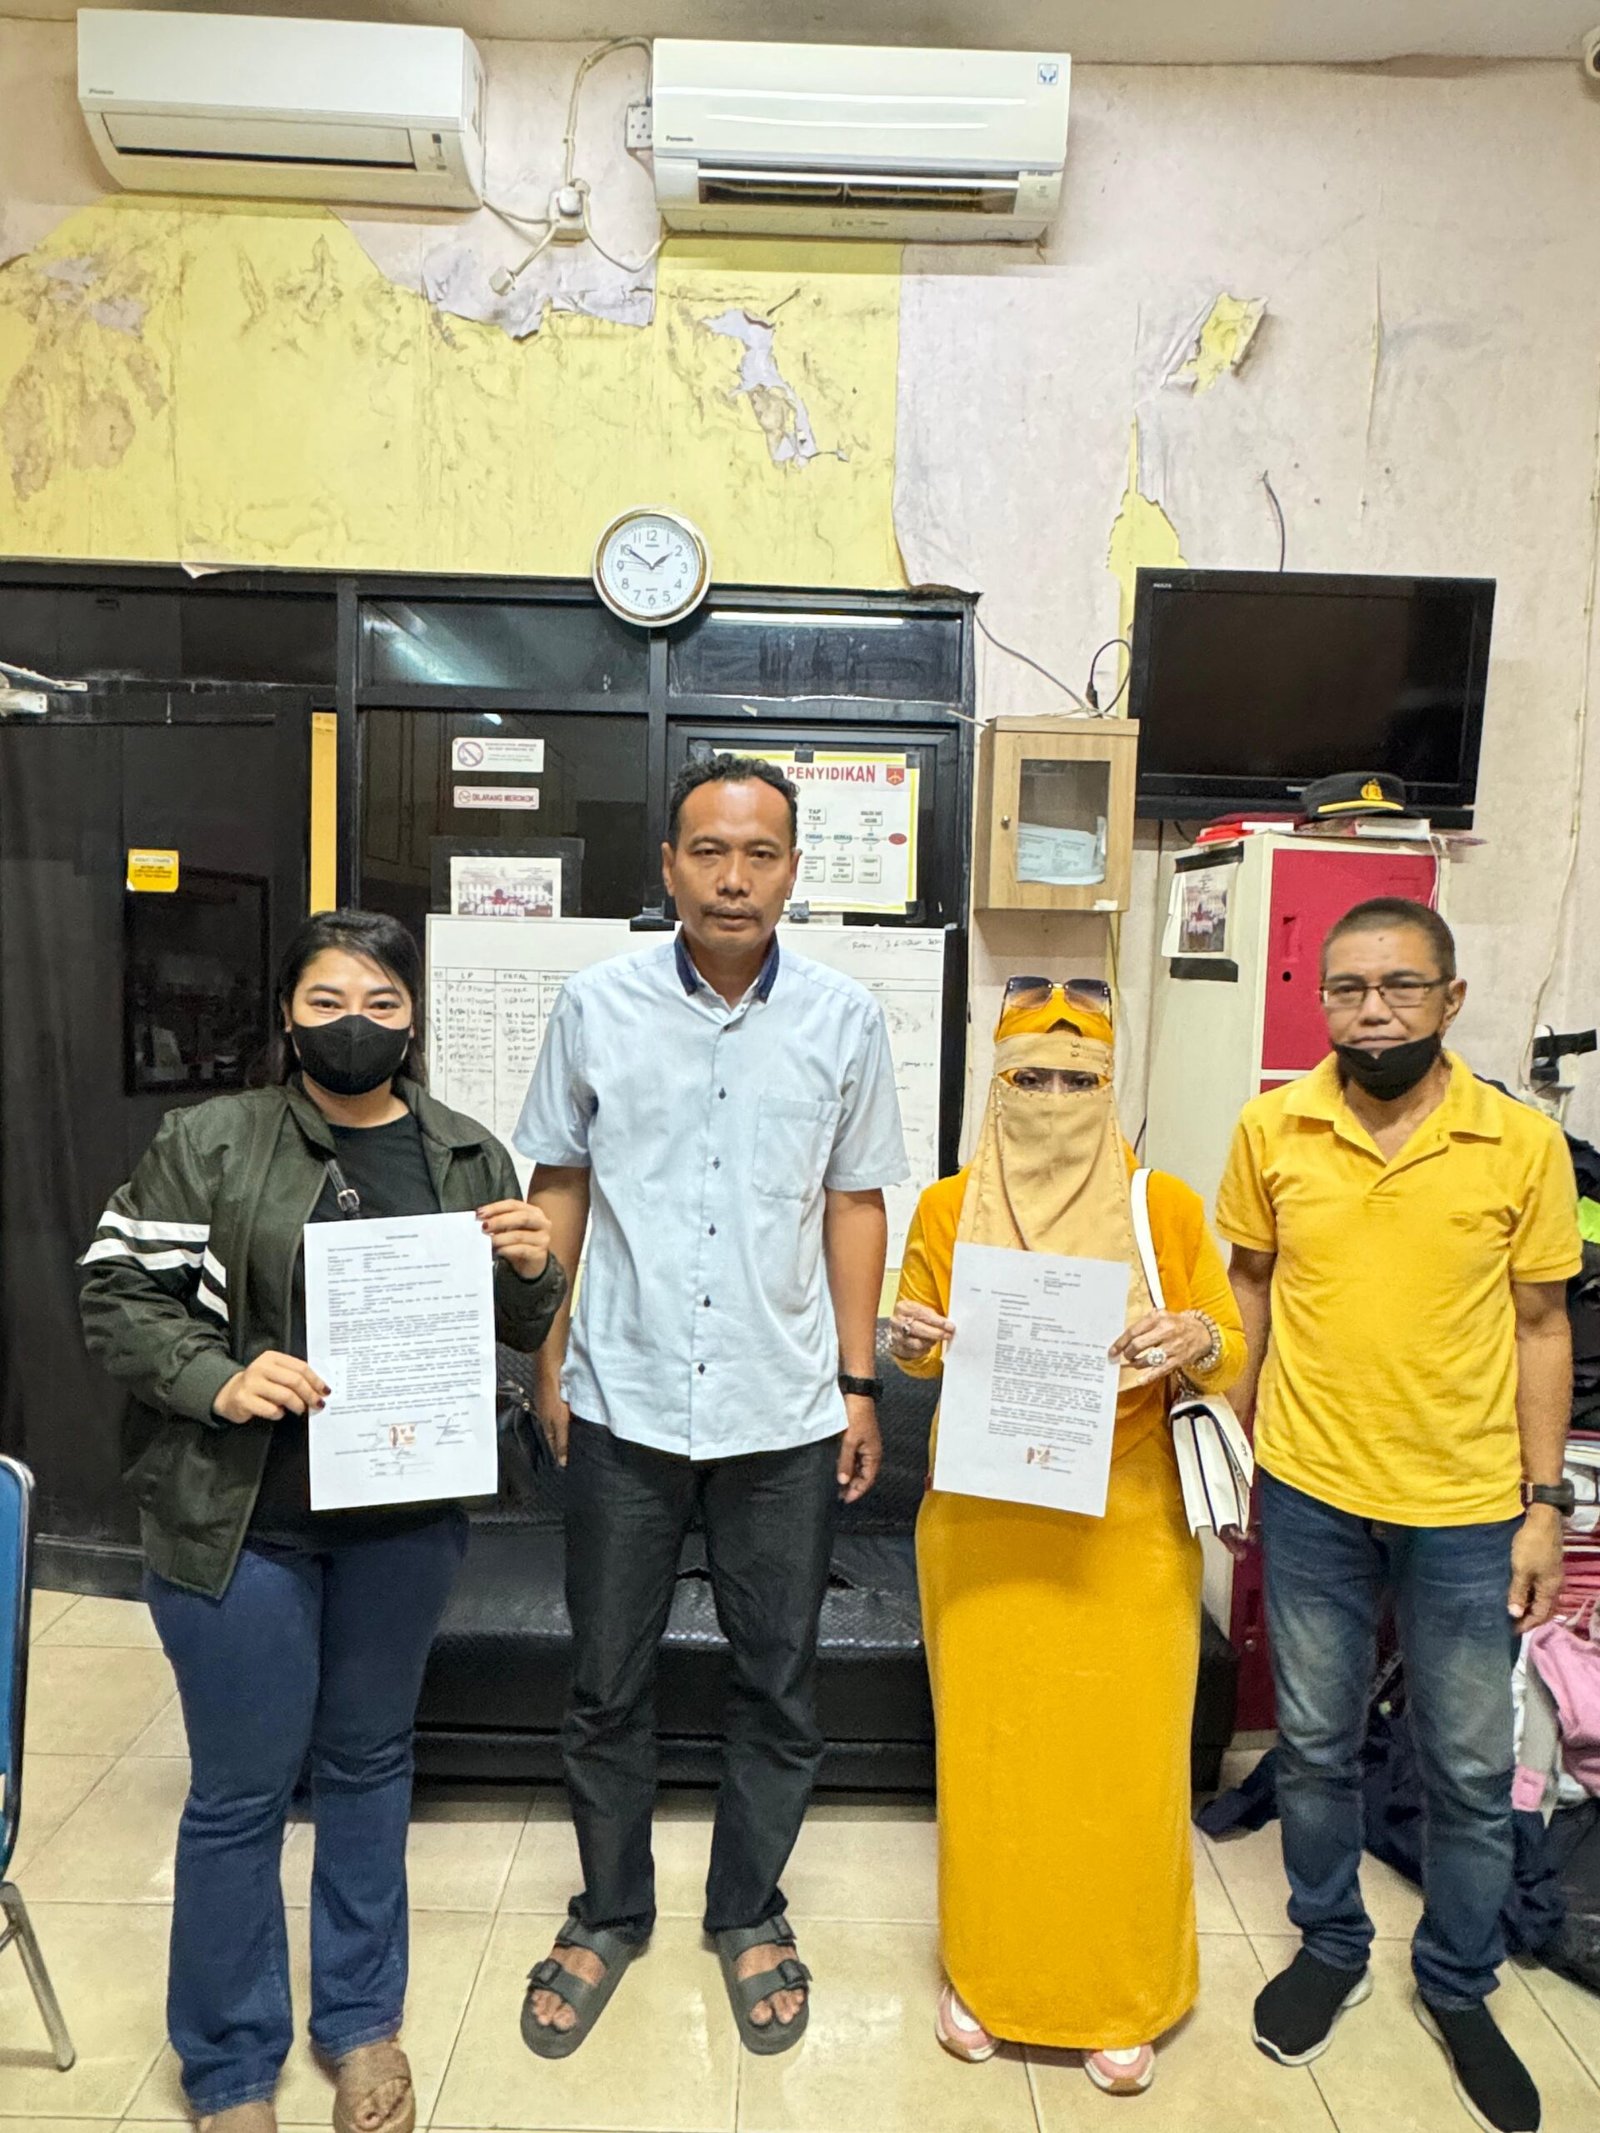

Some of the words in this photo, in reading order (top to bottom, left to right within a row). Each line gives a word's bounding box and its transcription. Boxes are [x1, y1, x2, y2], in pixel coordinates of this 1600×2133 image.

[633, 532, 641, 544] 11
[646, 529, 658, 541] 12
[674, 544, 683, 557] 2
[616, 560, 624, 572] 9
[680, 562, 688, 574] 3
[621, 578, 629, 590] 8
[674, 578, 682, 589] 4
[633, 589, 641, 601] 7
[648, 594, 656, 606] 6
[662, 590, 671, 602] 5
[786, 764, 876, 783] PENYIDIKAN
[472, 793, 502, 802] DILARANG
